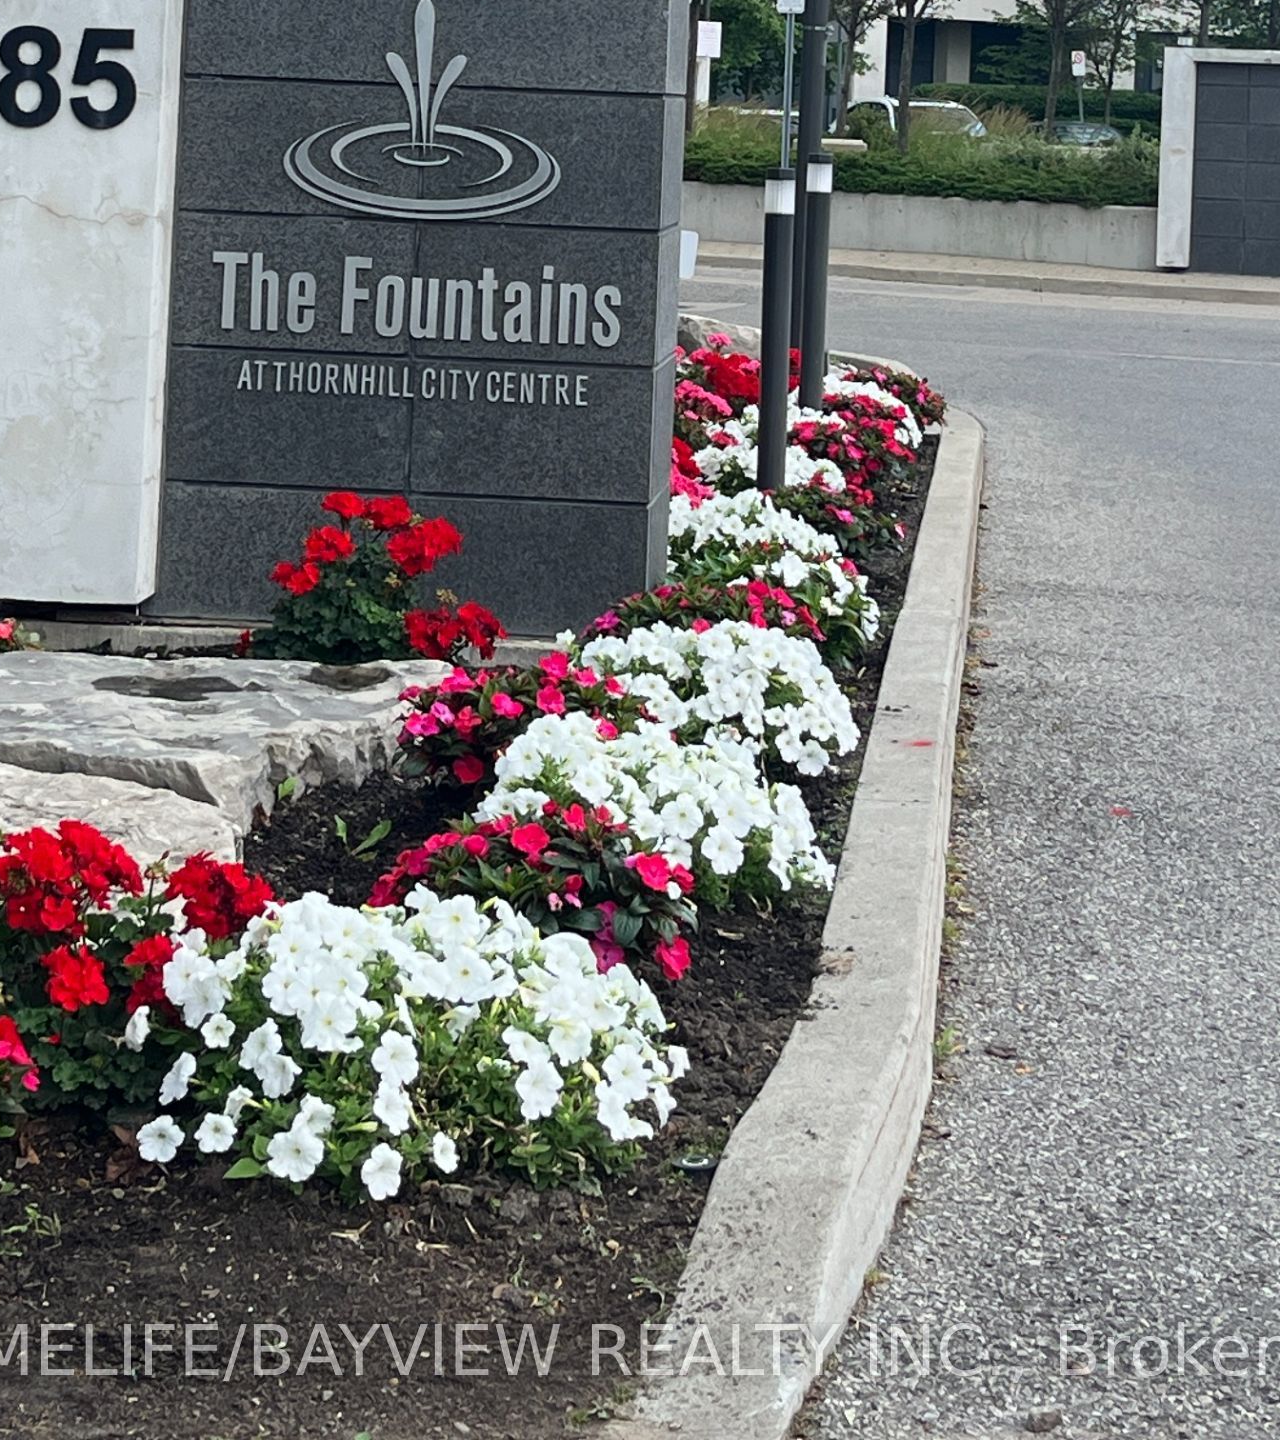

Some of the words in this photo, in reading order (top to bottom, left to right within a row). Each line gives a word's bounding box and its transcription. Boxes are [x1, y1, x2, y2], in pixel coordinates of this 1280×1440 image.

[212, 251, 317, 335] The
[339, 255, 621, 348] Fountains
[236, 359, 269, 391] AT
[271, 360, 415, 399] THORNHILL
[420, 366, 481, 403] CITY
[485, 370, 590, 407] CENTRE
